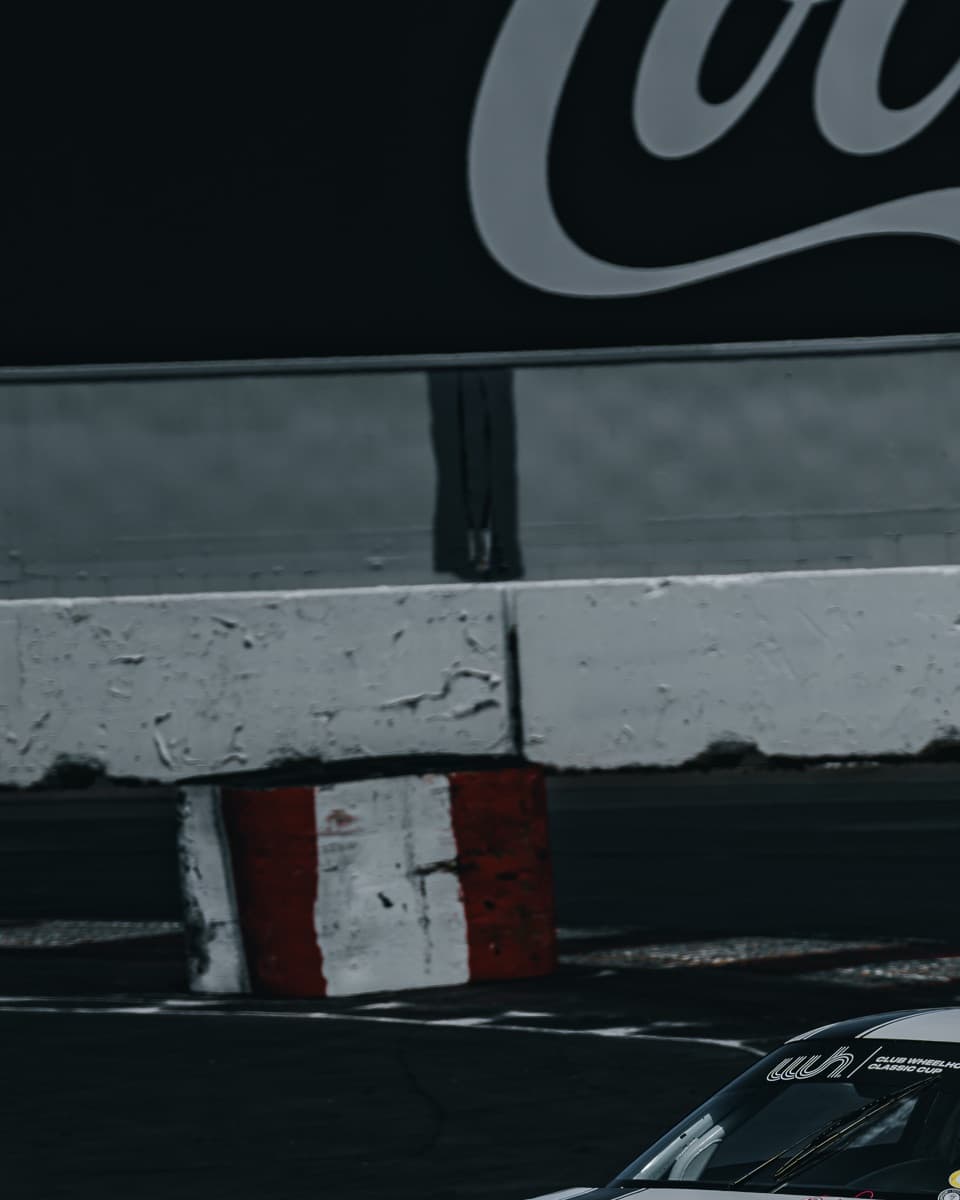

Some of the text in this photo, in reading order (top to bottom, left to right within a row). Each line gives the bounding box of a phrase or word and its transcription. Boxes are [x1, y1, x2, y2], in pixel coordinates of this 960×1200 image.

[875, 1056, 908, 1065] CLUB
[867, 1063, 944, 1075] CLASSIC CUP
